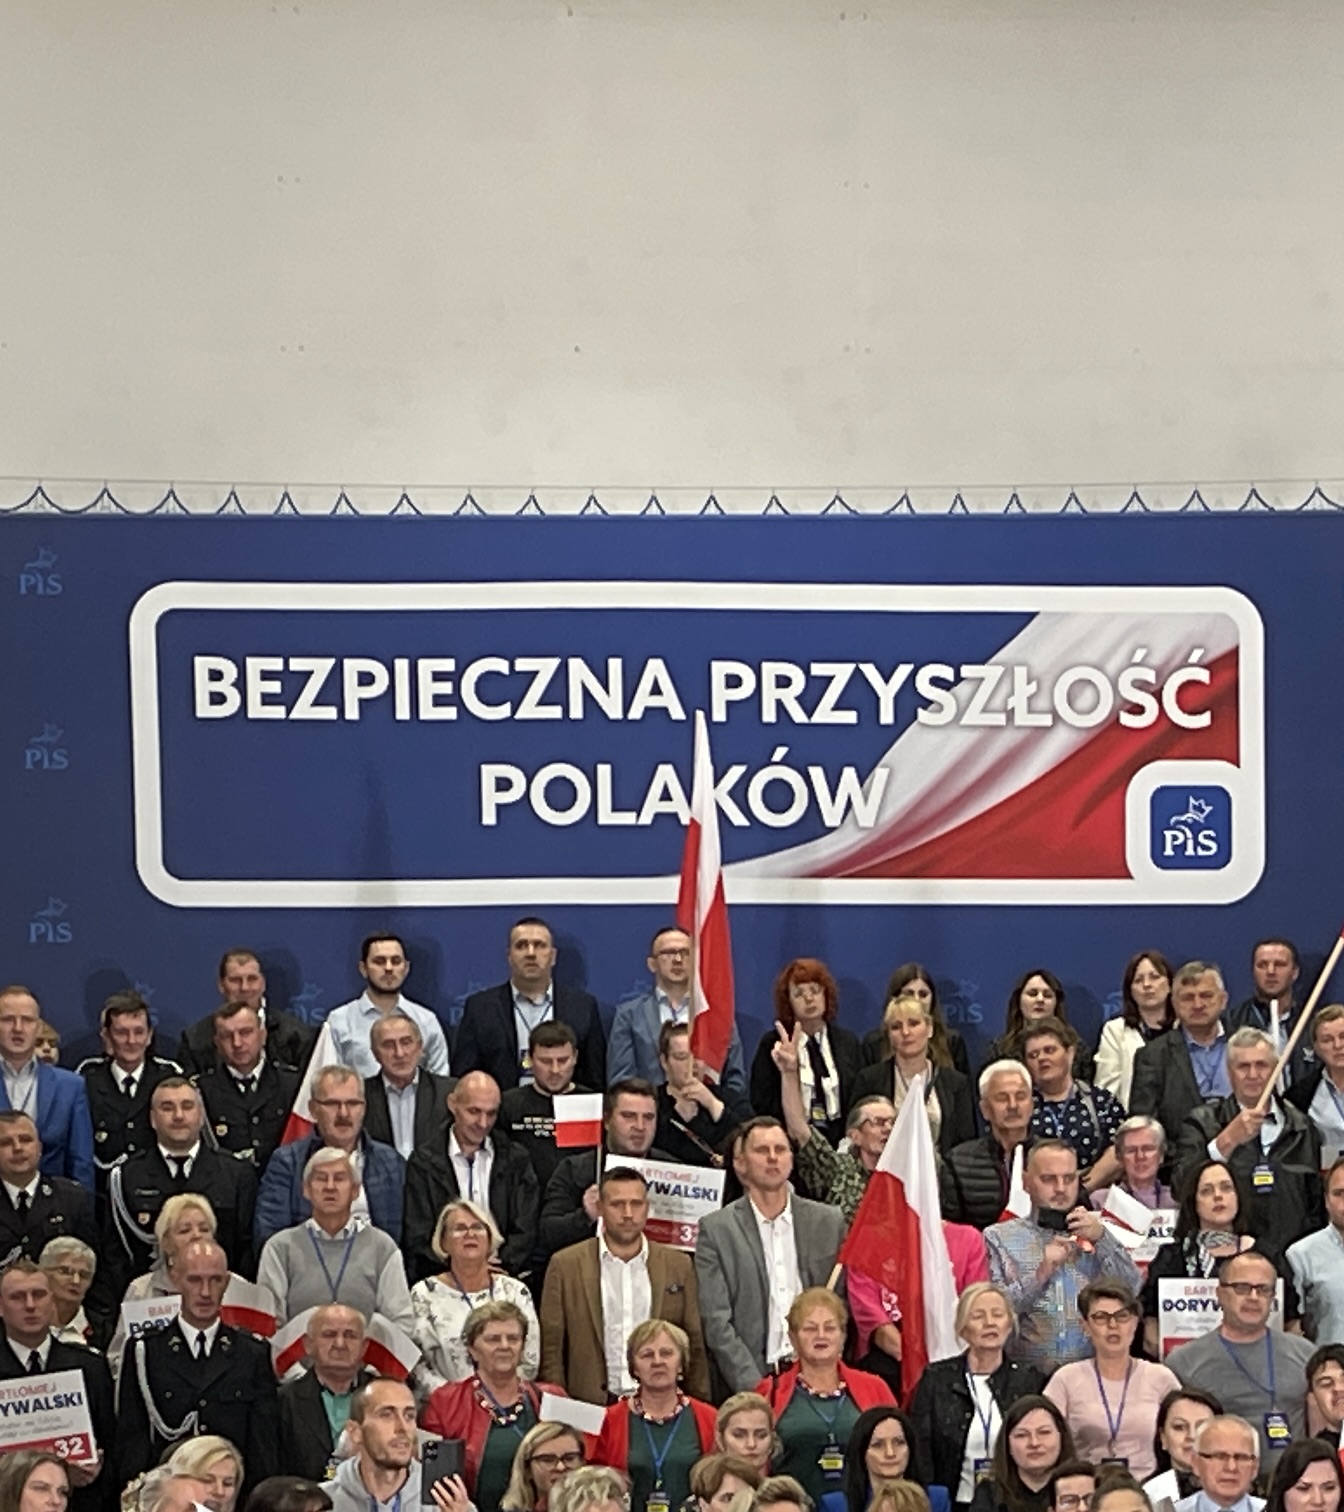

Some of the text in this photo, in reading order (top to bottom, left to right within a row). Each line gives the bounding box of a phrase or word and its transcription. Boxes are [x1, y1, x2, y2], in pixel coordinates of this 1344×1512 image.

[193, 647, 1214, 729] BEZPIECZNA PRZYSZŁOŚĆ
[480, 746, 891, 829] POLAKÓW
[1163, 829, 1218, 857] PiS
[646, 1180, 719, 1202] YWALSKI
[54, 1437, 86, 1459] 32
